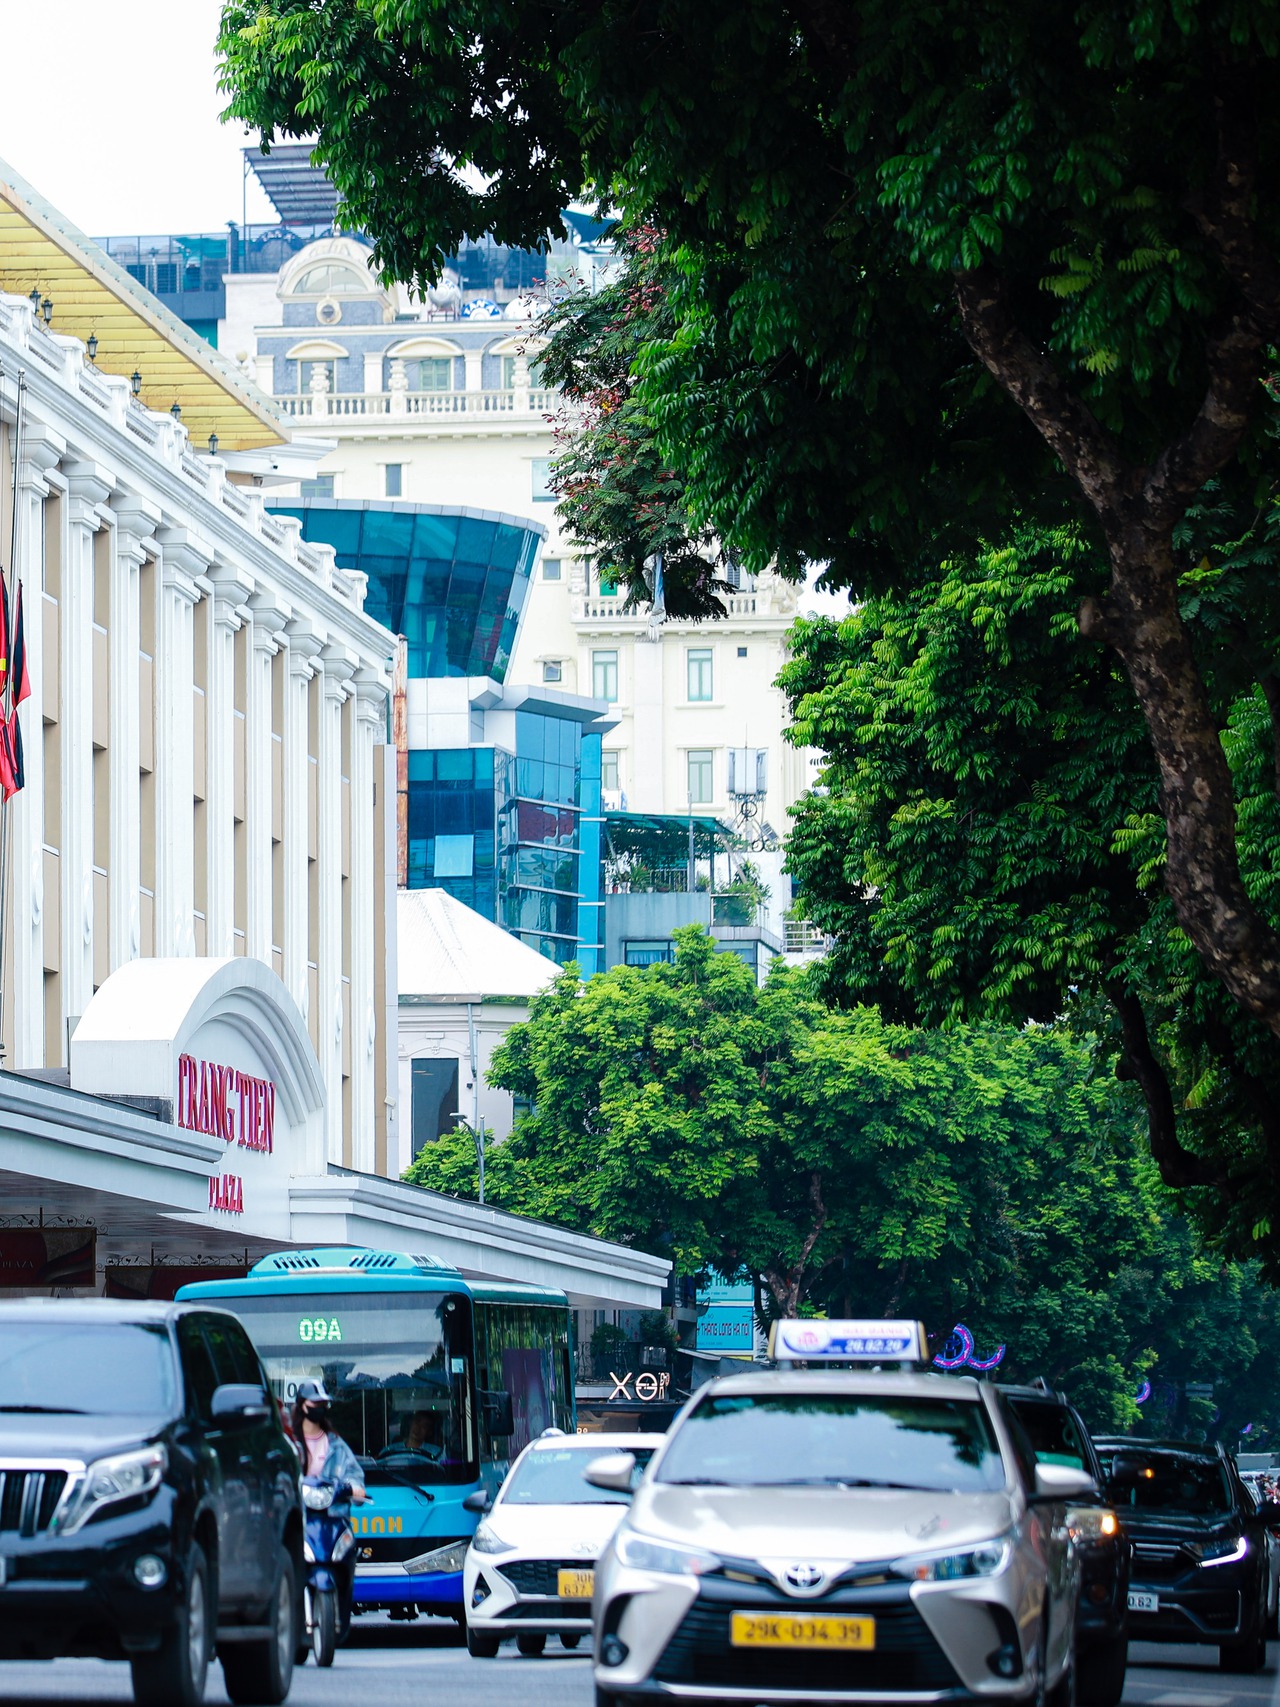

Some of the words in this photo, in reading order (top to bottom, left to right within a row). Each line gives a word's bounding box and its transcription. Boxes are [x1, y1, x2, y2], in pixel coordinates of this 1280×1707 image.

[178, 1053, 235, 1143] TRANG
[236, 1070, 277, 1154] TIEN
[209, 1173, 244, 1213] PLAZA
[299, 1317, 342, 1342] 09A
